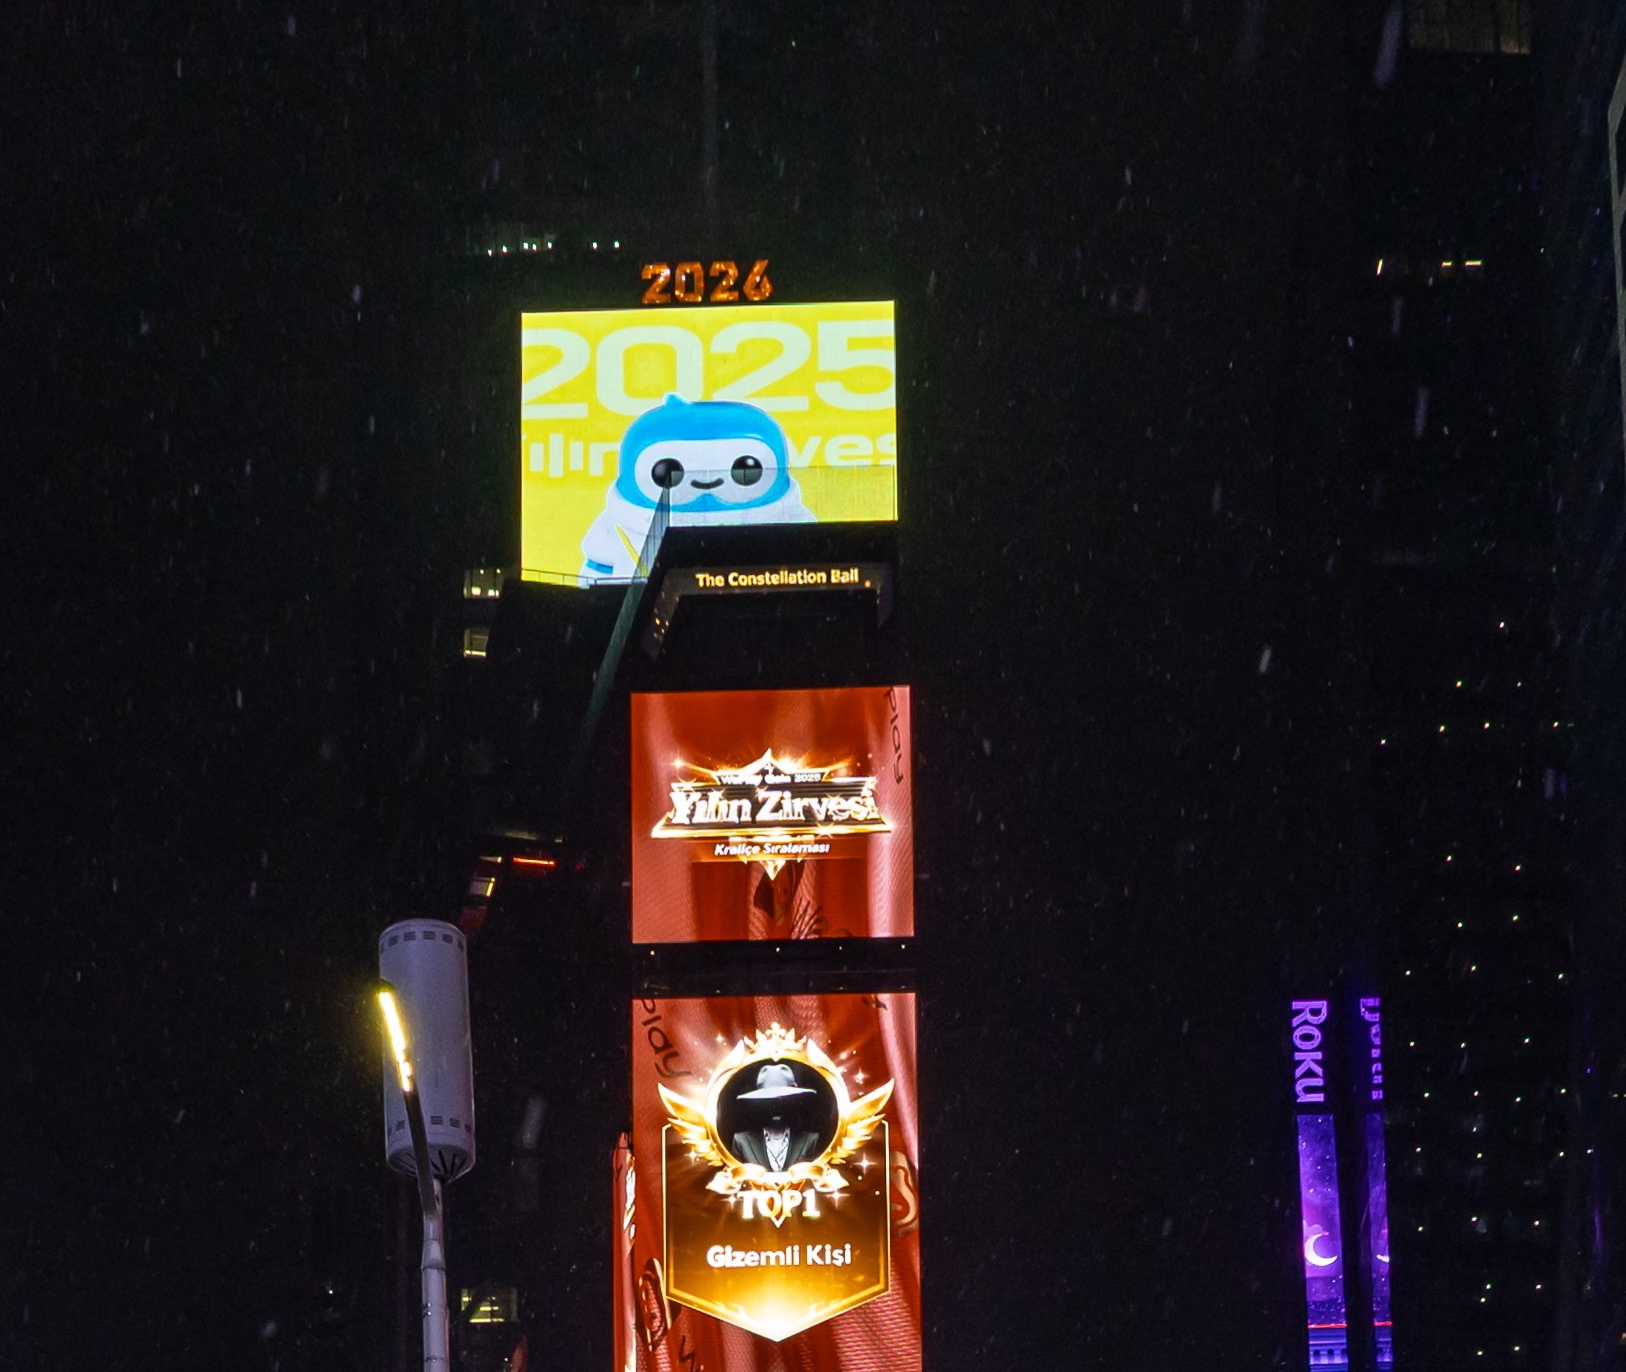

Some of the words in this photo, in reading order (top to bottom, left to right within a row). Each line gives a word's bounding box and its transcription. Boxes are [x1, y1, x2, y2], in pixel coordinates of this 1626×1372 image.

[642, 259, 773, 304] 2026
[522, 319, 895, 419] 2025
[696, 572, 725, 587] The
[728, 569, 828, 587] Constellation
[830, 568, 860, 585] Ball
[737, 1188, 821, 1219] TOP1
[706, 1245, 800, 1268] Gizemli
[806, 1243, 852, 1267] Kişi
